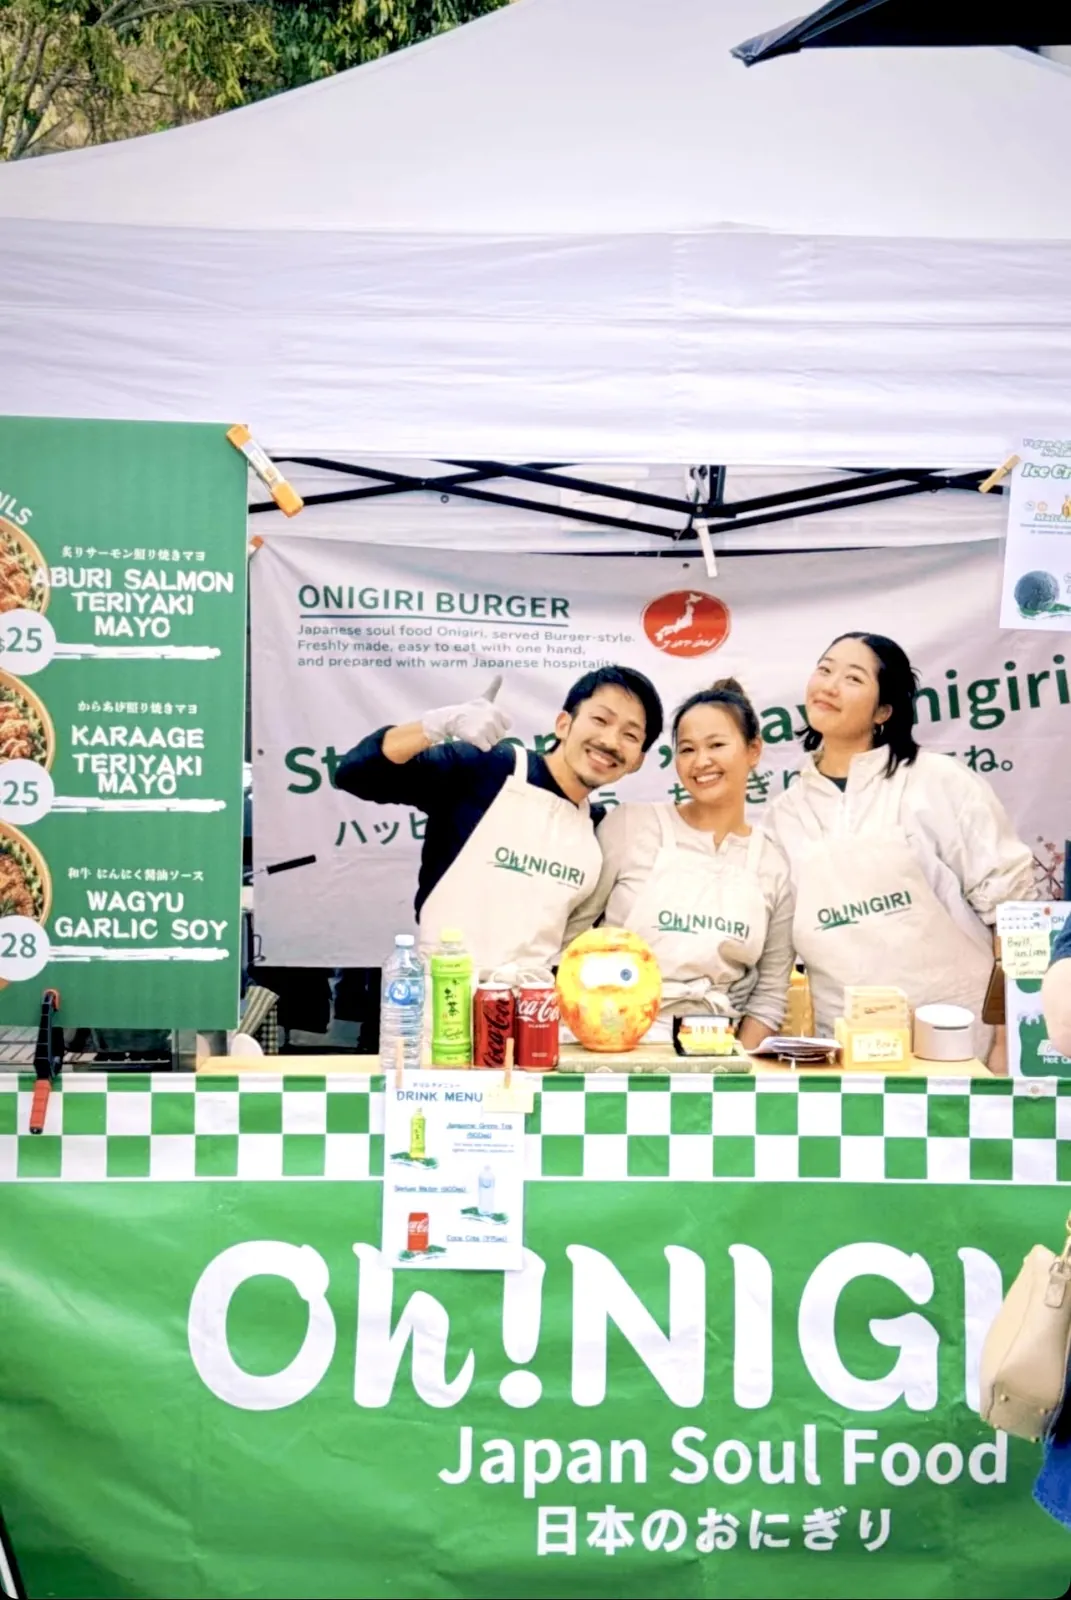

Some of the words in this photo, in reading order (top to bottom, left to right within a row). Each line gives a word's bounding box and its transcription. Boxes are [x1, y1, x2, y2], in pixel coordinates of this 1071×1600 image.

[1021, 462, 1050, 478] Ice
[1051, 463, 1071, 480] Cr
[32, 566, 111, 589] ABURI
[124, 568, 234, 593] SALMON
[71, 591, 194, 615] TERIYAKI
[298, 584, 424, 611] ONIGIRI
[436, 591, 571, 619] BURGER
[95, 615, 171, 638] MAYO
[297, 624, 362, 637] Japanese
[366, 624, 396, 637] soul
[400, 625, 433, 637] food
[492, 631, 539, 641] served
[298, 640, 349, 652] Freshly
[398, 643, 430, 654] easy
[435, 642, 449, 652] to
[454, 643, 476, 652] eat
[481, 643, 511, 653] with
[516, 645, 542, 653] one
[298, 656, 323, 667] and
[329, 657, 392, 668] prepared
[396, 657, 425, 667] with
[430, 658, 467, 668] warm
[473, 658, 539, 669] Japanese
[912, 654, 1070, 730] nigiri
[71, 725, 205, 748] KARAAGE
[72, 753, 202, 776] TERIYAKI
[98, 773, 177, 795] MAYO
[87, 890, 184, 912] WAGYU
[54, 916, 158, 939] GARLIC
[171, 918, 229, 941] SOY
[396, 1090, 438, 1102] DRINK
[445, 1091, 483, 1103] MENU
[187, 1238, 1003, 1413] Oh!NIGI
[437, 1426, 648, 1498] Japan
[670, 1424, 822, 1487] Soul
[843, 1429, 1009, 1487] Food
[536, 1505, 893, 1557] 日本のおにぎり
